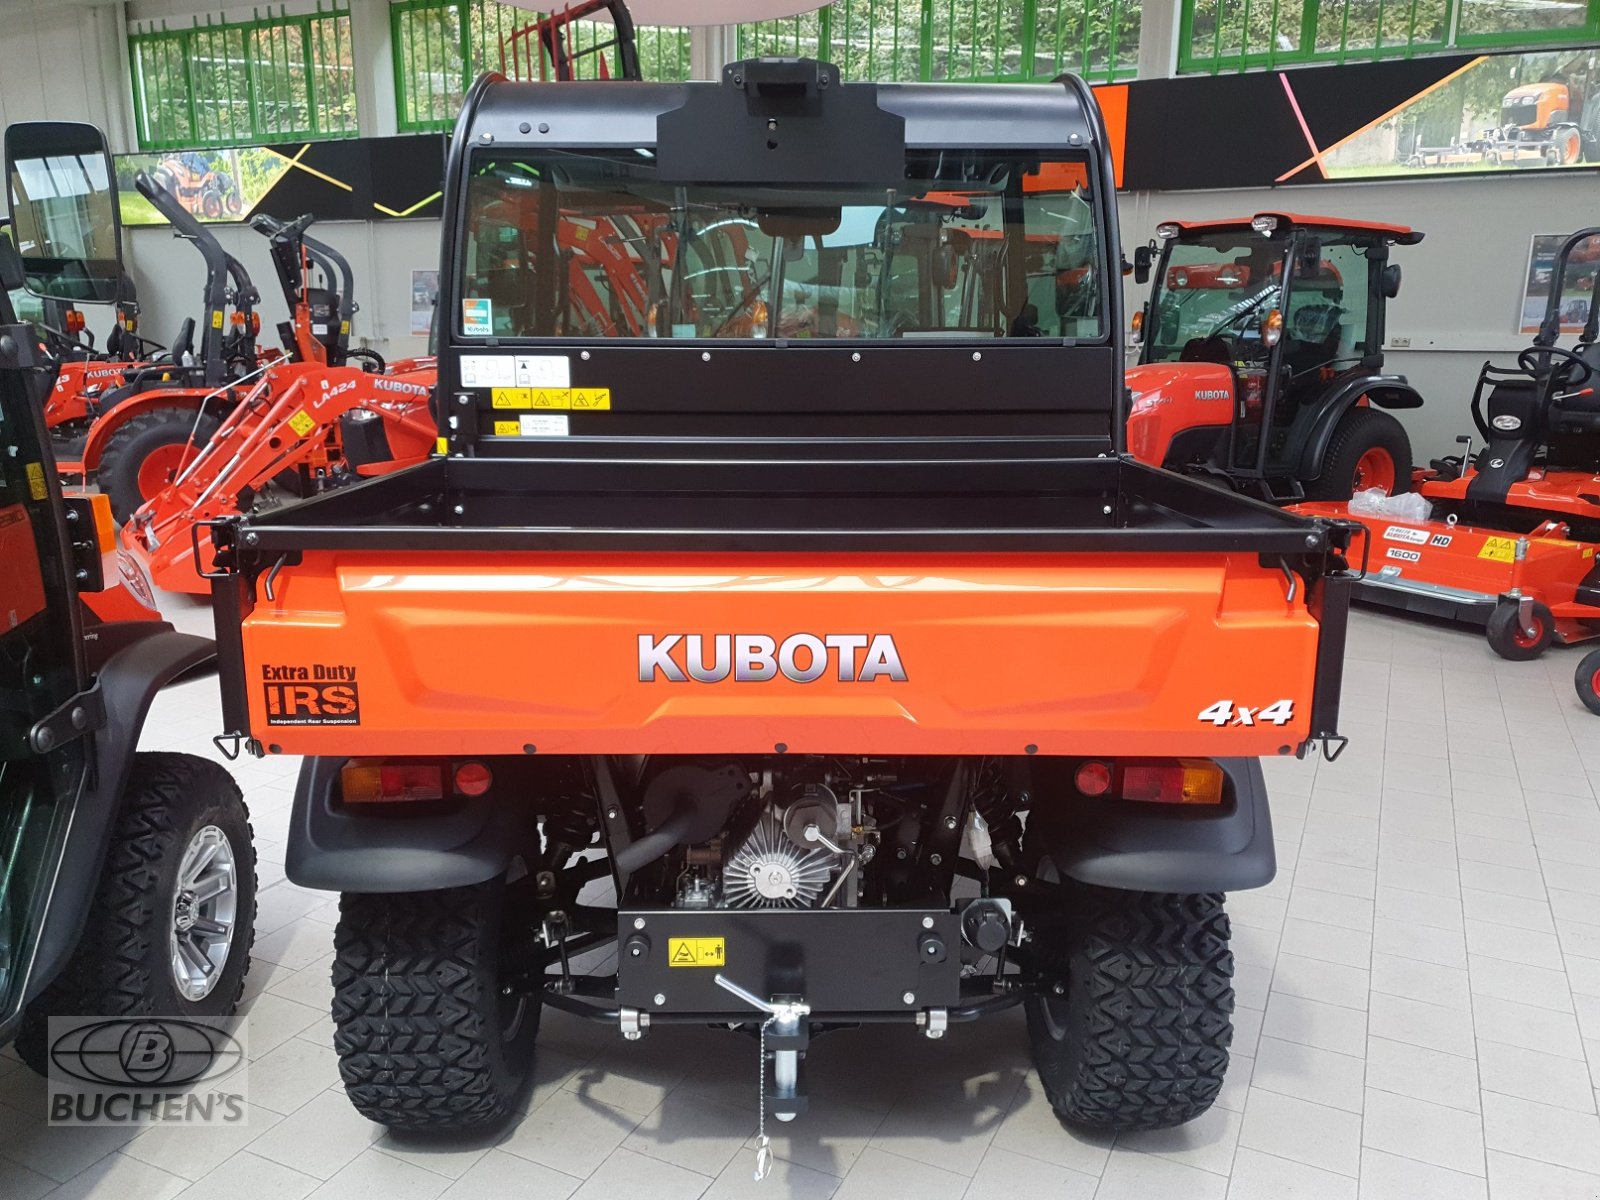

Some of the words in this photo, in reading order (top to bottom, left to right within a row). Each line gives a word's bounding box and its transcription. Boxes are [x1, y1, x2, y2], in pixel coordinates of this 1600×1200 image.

[87, 367, 125, 379] KUBOT
[313, 379, 357, 409] LA424
[374, 378, 428, 396] KUBOTA
[1194, 390, 1230, 400] KUBOTA
[1432, 535, 1450, 546] HD
[1390, 549, 1419, 560] 1600
[637, 632, 909, 684] KUBOTA
[262, 664, 309, 680] Extra
[313, 664, 356, 681] Duty
[267, 685, 357, 715] IRS
[1197, 699, 1295, 727] 4x4
